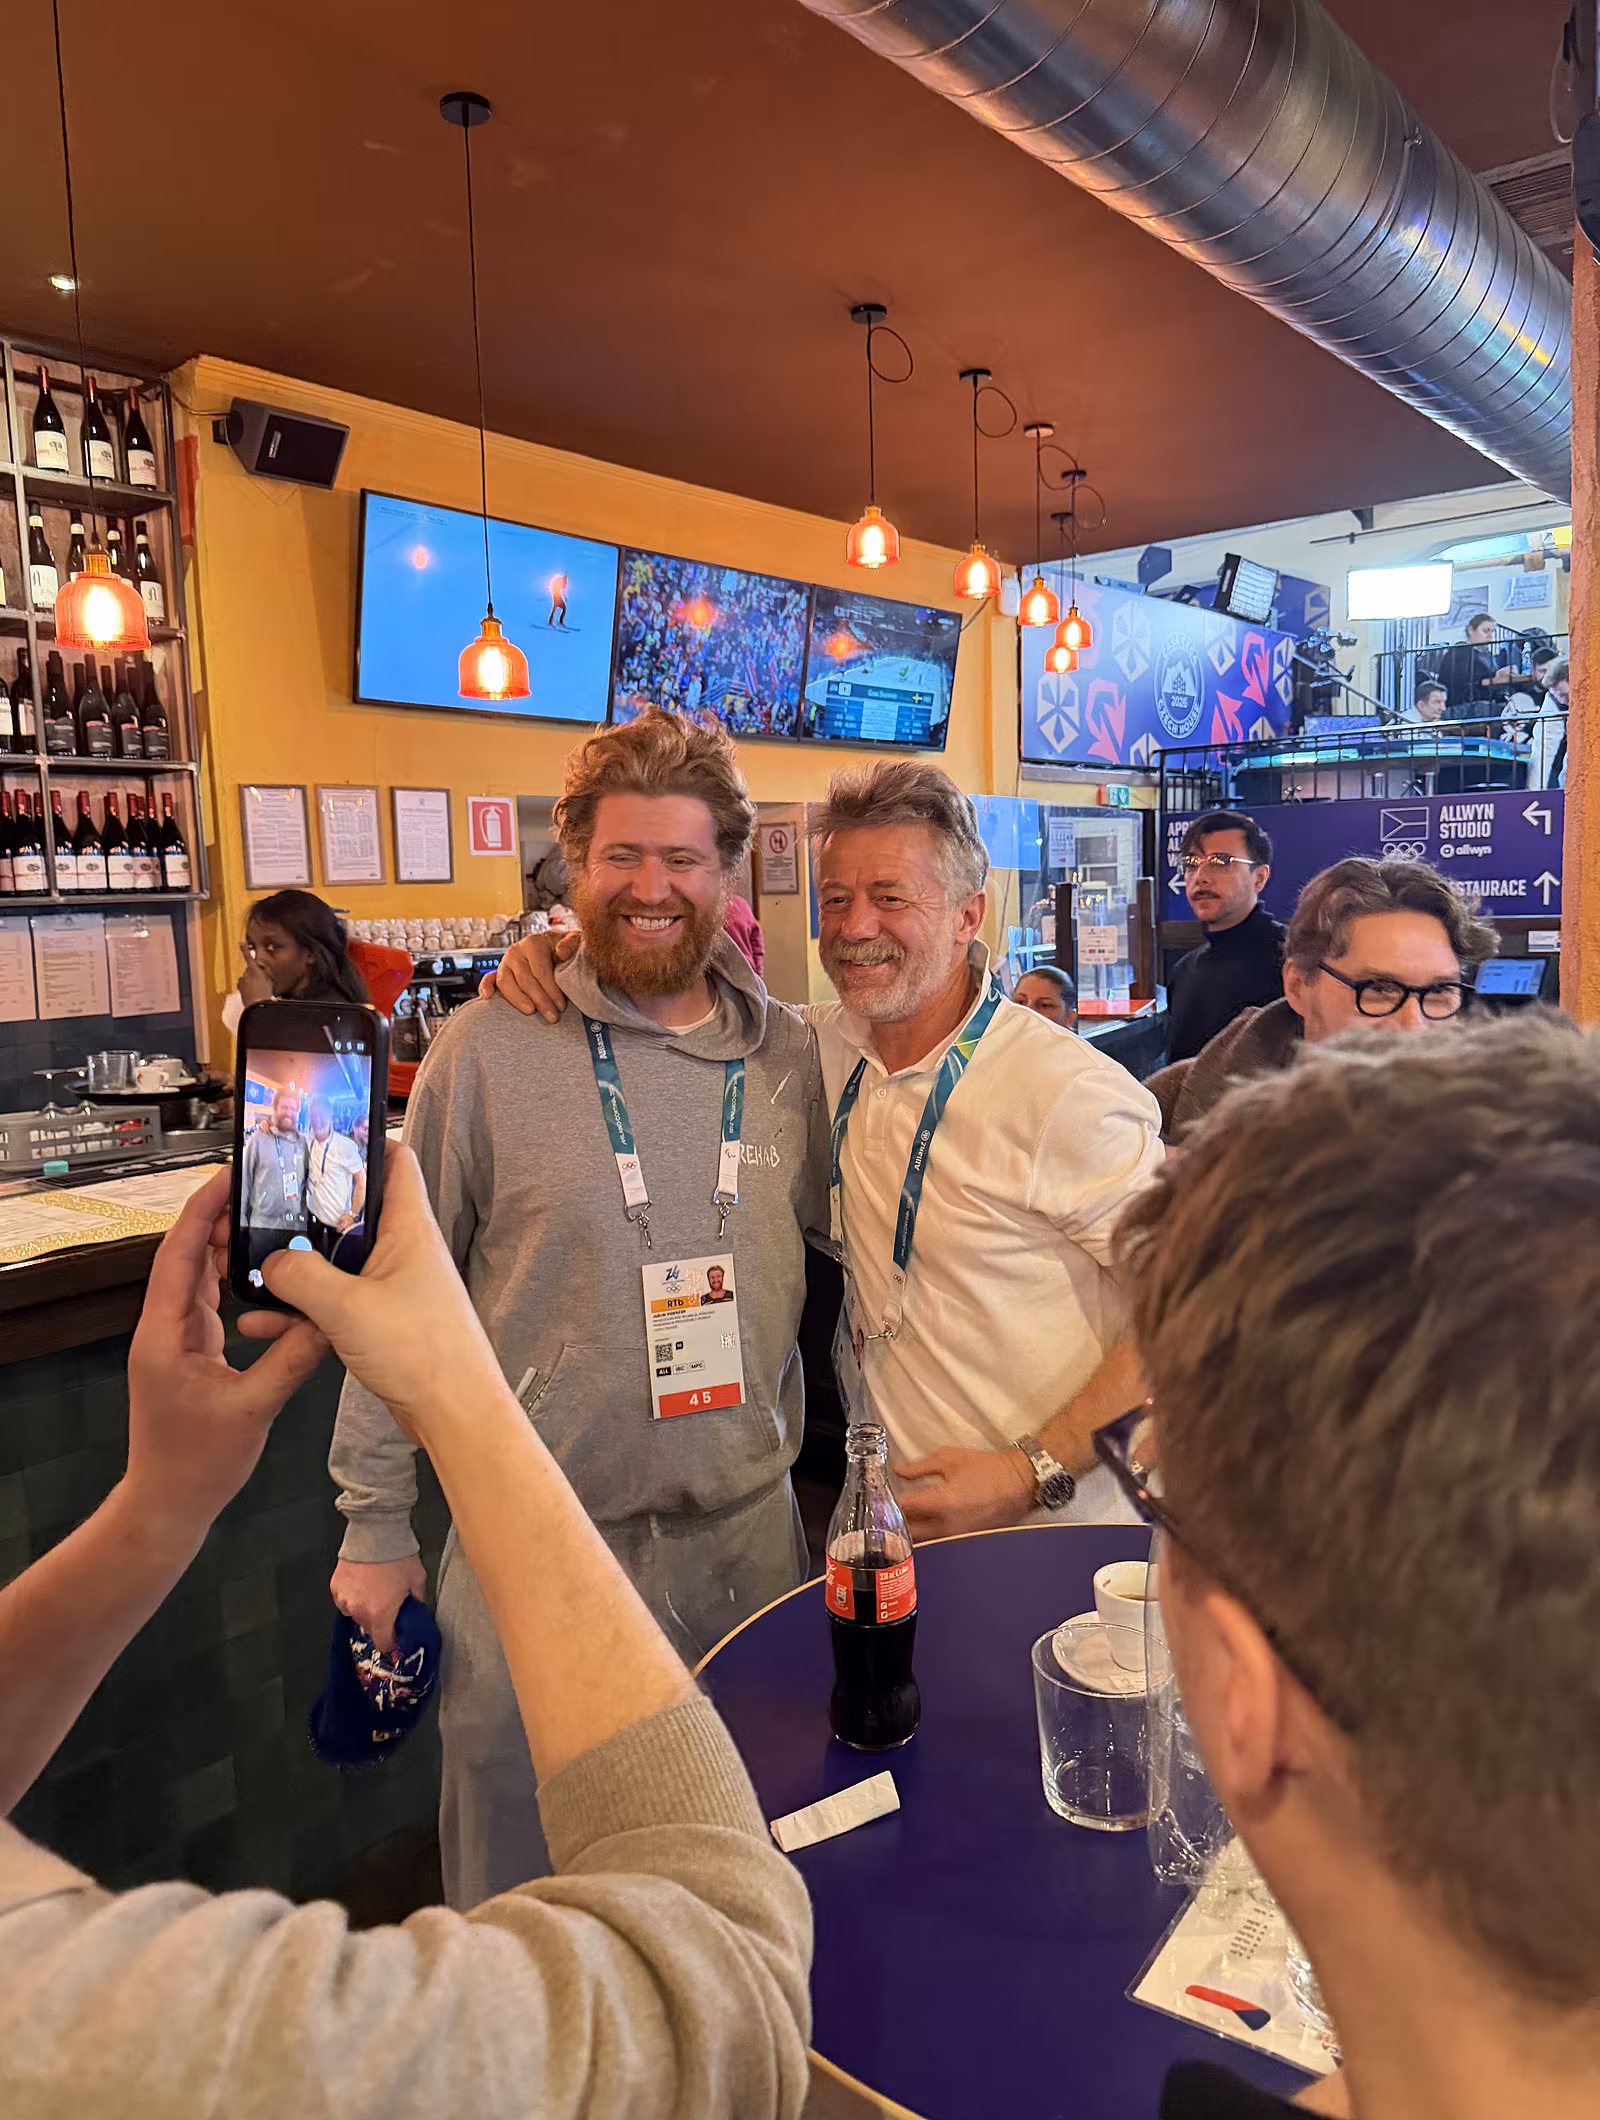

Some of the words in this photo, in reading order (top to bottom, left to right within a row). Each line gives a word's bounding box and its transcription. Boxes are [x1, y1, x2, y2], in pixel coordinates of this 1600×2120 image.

[1171, 696, 1188, 708] 2026
[1158, 699, 1178, 734] CZECH
[1179, 703, 1200, 734] HOUSE
[1439, 803, 1494, 822] ALLWYN
[1167, 821, 1194, 837] APR
[1439, 821, 1491, 839] STUDIO
[1456, 844, 1492, 857] allwyn
[740, 1144, 780, 1168] REHAB
[913, 1142, 927, 1171] Allianz
[667, 1299, 684, 1308] RTb
[689, 1393, 699, 1406] 4
[702, 1391, 711, 1404] 5
